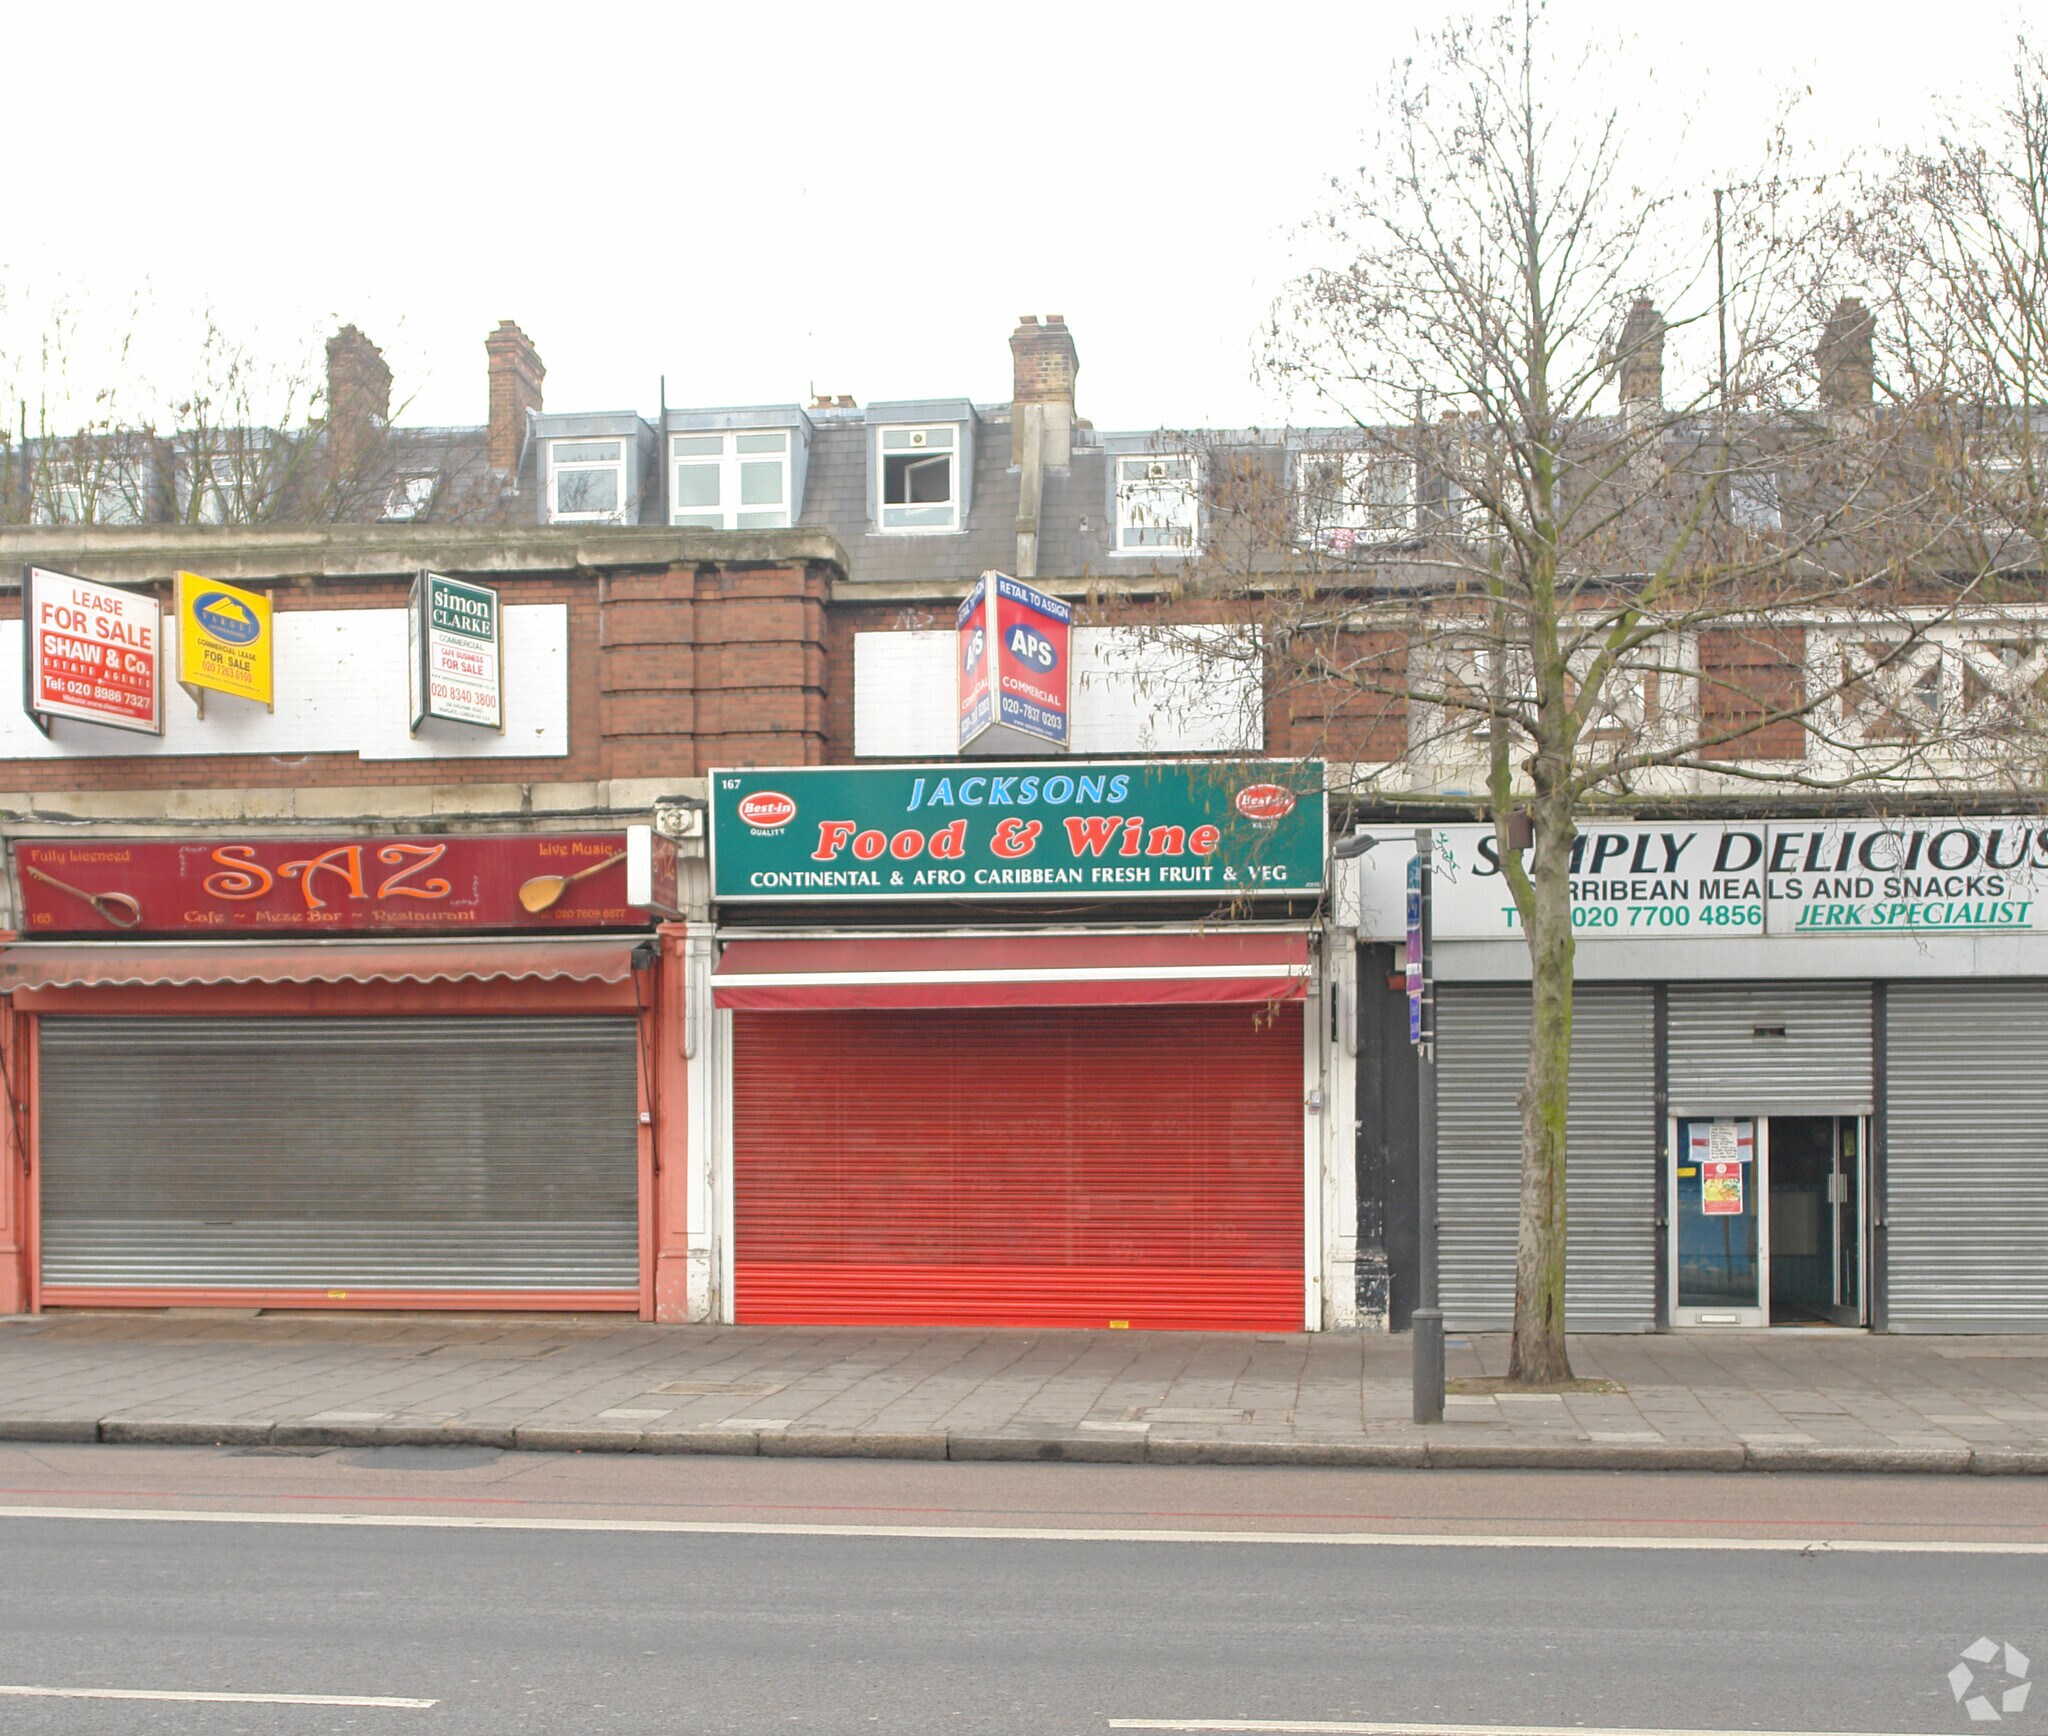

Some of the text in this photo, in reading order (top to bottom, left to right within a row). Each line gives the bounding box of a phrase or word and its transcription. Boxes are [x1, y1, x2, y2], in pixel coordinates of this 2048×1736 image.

[73, 589, 122, 616] LEASE
[434, 587, 489, 618] simon
[1000, 581, 1028, 601] RETAIL
[1030, 592, 1040, 606] TO
[1042, 598, 1068, 619] ASSIGN
[42, 602, 152, 650] FOR SALE
[433, 609, 490, 635] CLARKE
[198, 638, 256, 661] COMMERCIAL LEASE
[439, 634, 484, 650] COMMERCIAL
[1010, 629, 1052, 666] APS
[44, 634, 150, 676] SHAW & Co.
[204, 650, 250, 672] FOR SALE
[441, 648, 484, 664] CAFE BUSINESS
[442, 658, 484, 676] FOR SALE
[44, 657, 150, 688] ESTATE AGENTS
[44, 676, 150, 708] Tel: 020 8986 7327
[432, 682, 448, 698] 020
[450, 687, 472, 703] 8340
[474, 692, 496, 708] 3800
[1002, 676, 1061, 706] COMMERCIAL
[1042, 712, 1062, 730] 0203
[722, 779, 741, 790] 167
[907, 774, 1130, 811] JACKSONS
[744, 802, 791, 814] Best-in
[750, 828, 785, 837] QUALITY
[811, 816, 1220, 860] Food & Wine
[31, 850, 65, 864] Fully
[539, 842, 568, 856] Live
[203, 843, 451, 910] SAZ
[750, 865, 1287, 887] CONTINENTAL & AFRO CARIBBEAN FRESH FRUIT & VEG
[1700, 878, 1803, 900] MEALS
[1812, 878, 1874, 899] AND
[1884, 875, 2005, 898] SNACKS
[184, 909, 476, 924] Cafe Meze Bar Restaurant
[1572, 904, 1762, 927] 020 7700 4856
[1796, 901, 2034, 926] JERK SPECIALIST
